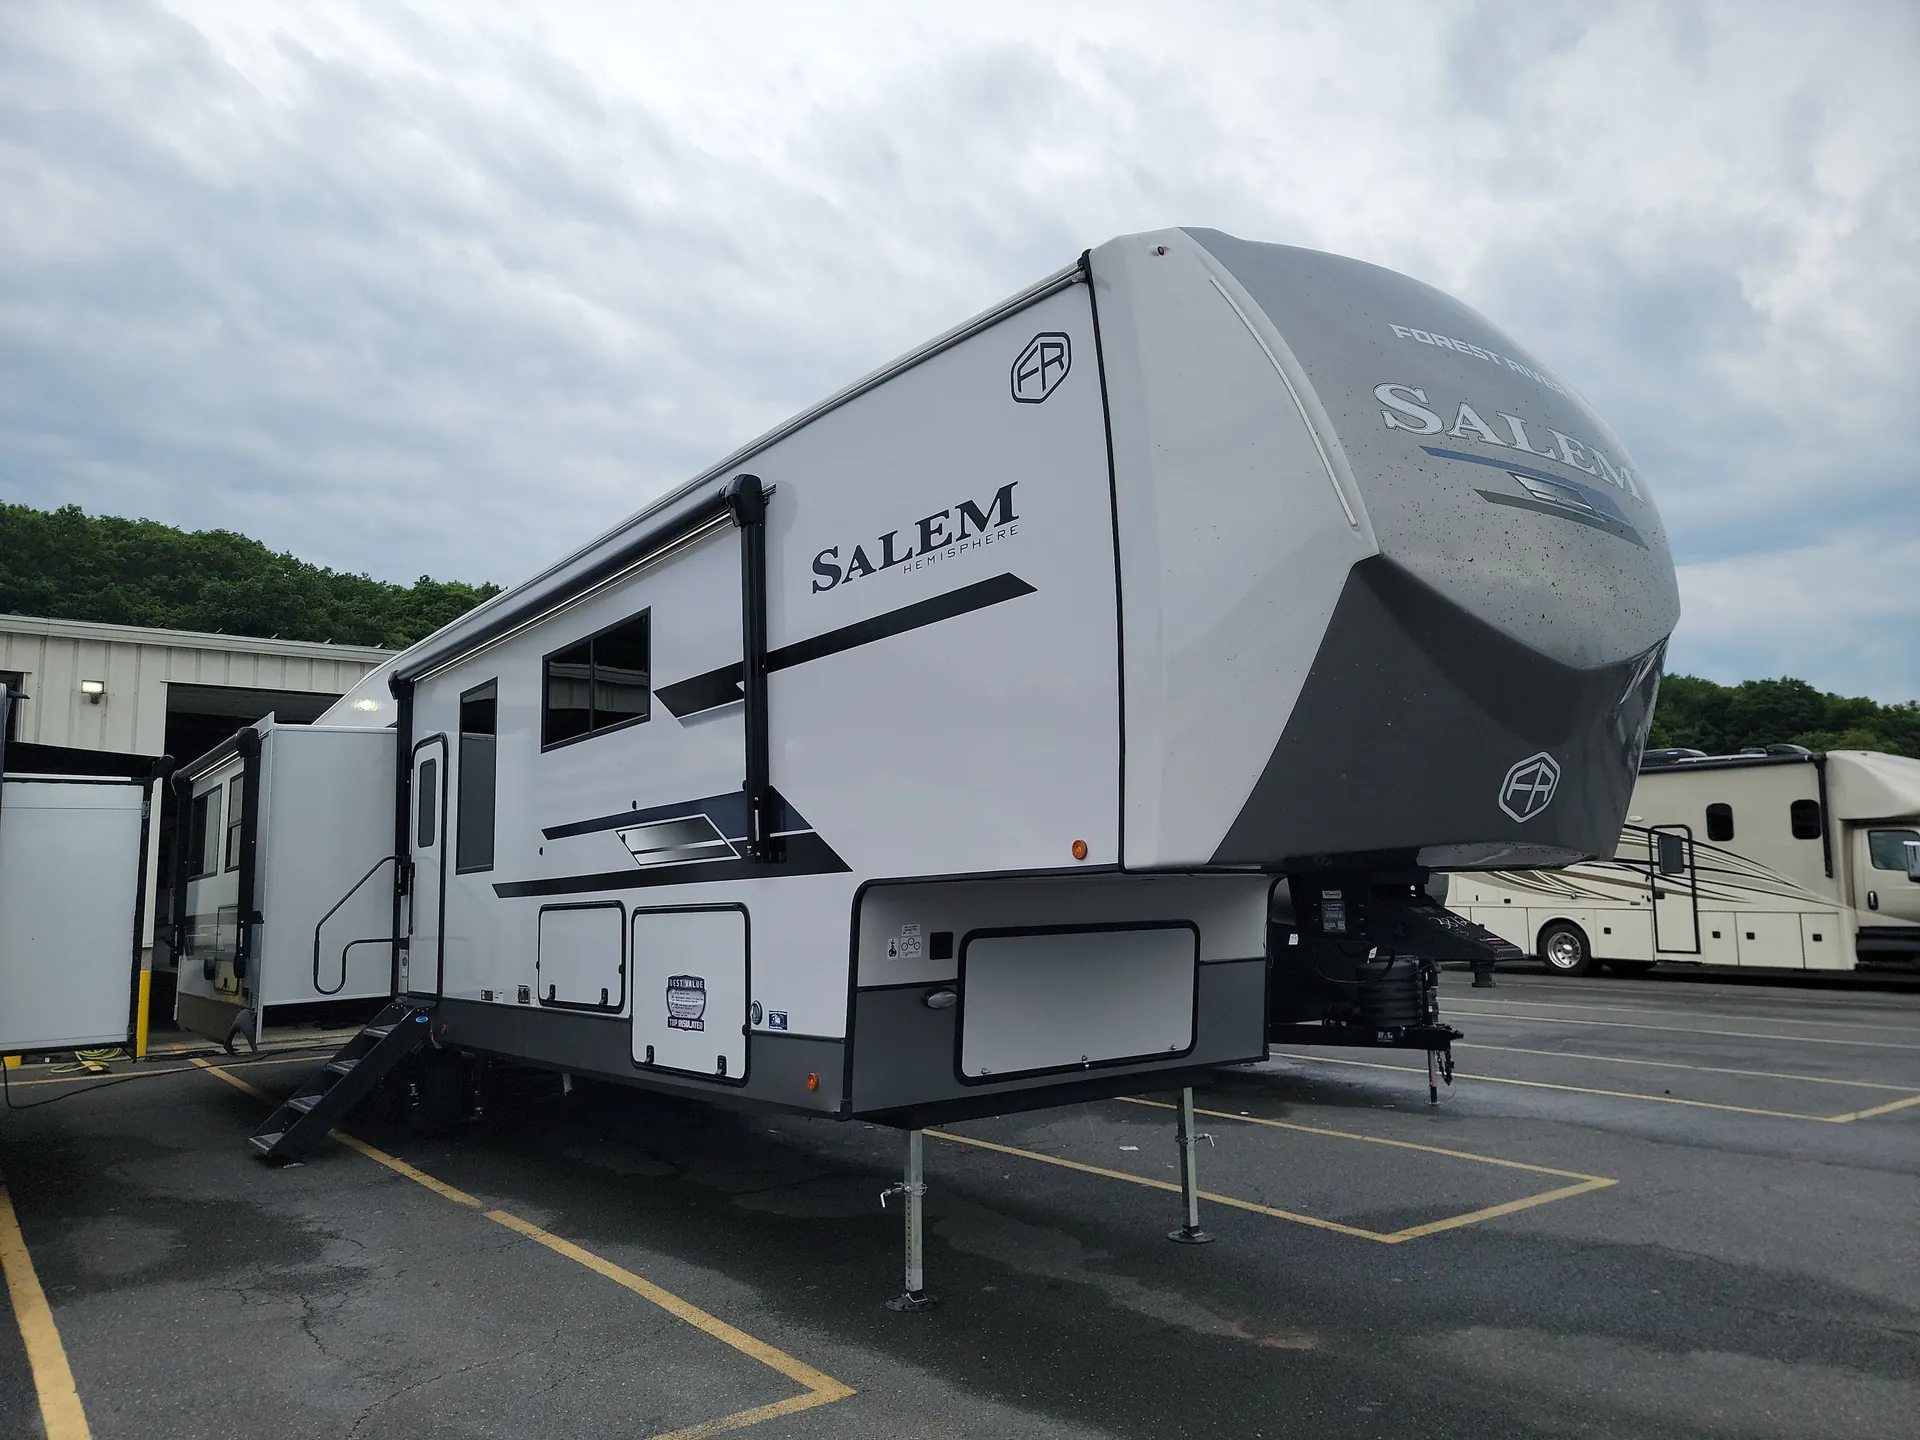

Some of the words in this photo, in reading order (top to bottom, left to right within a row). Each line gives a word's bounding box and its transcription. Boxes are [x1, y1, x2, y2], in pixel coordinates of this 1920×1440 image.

[1387, 323, 1501, 366] FOREST
[1502, 356, 1570, 399] RIVER
[1372, 382, 1646, 506] SALEM
[811, 480, 1020, 595] SALEM
[903, 523, 1020, 575] HEMISPHERE
[669, 978, 683, 988] BEST
[684, 979, 704, 989] VALUE
